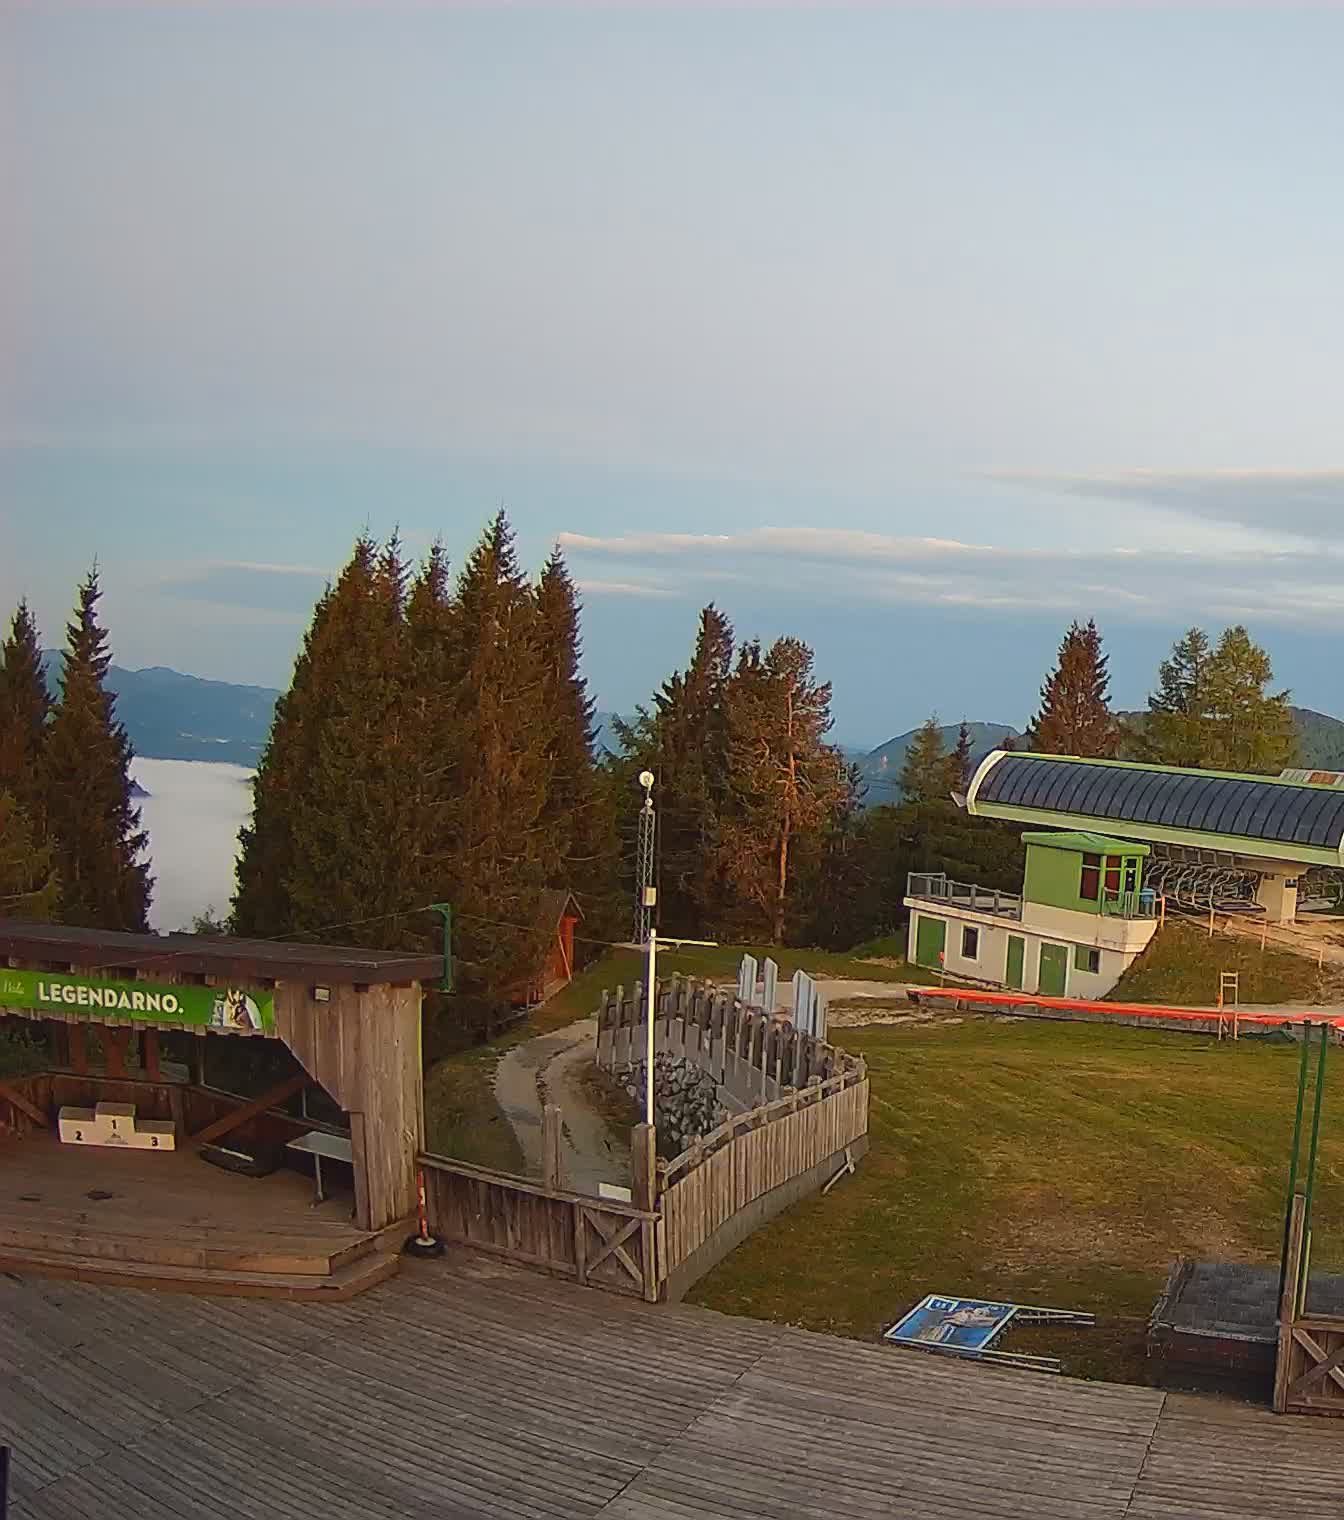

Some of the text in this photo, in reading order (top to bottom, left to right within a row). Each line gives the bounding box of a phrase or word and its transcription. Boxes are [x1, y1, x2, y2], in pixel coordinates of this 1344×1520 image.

[37, 981, 185, 1015] LEGENDARNO.
[75, 1130, 83, 1142] 2
[150, 1136, 159, 1147] 3
